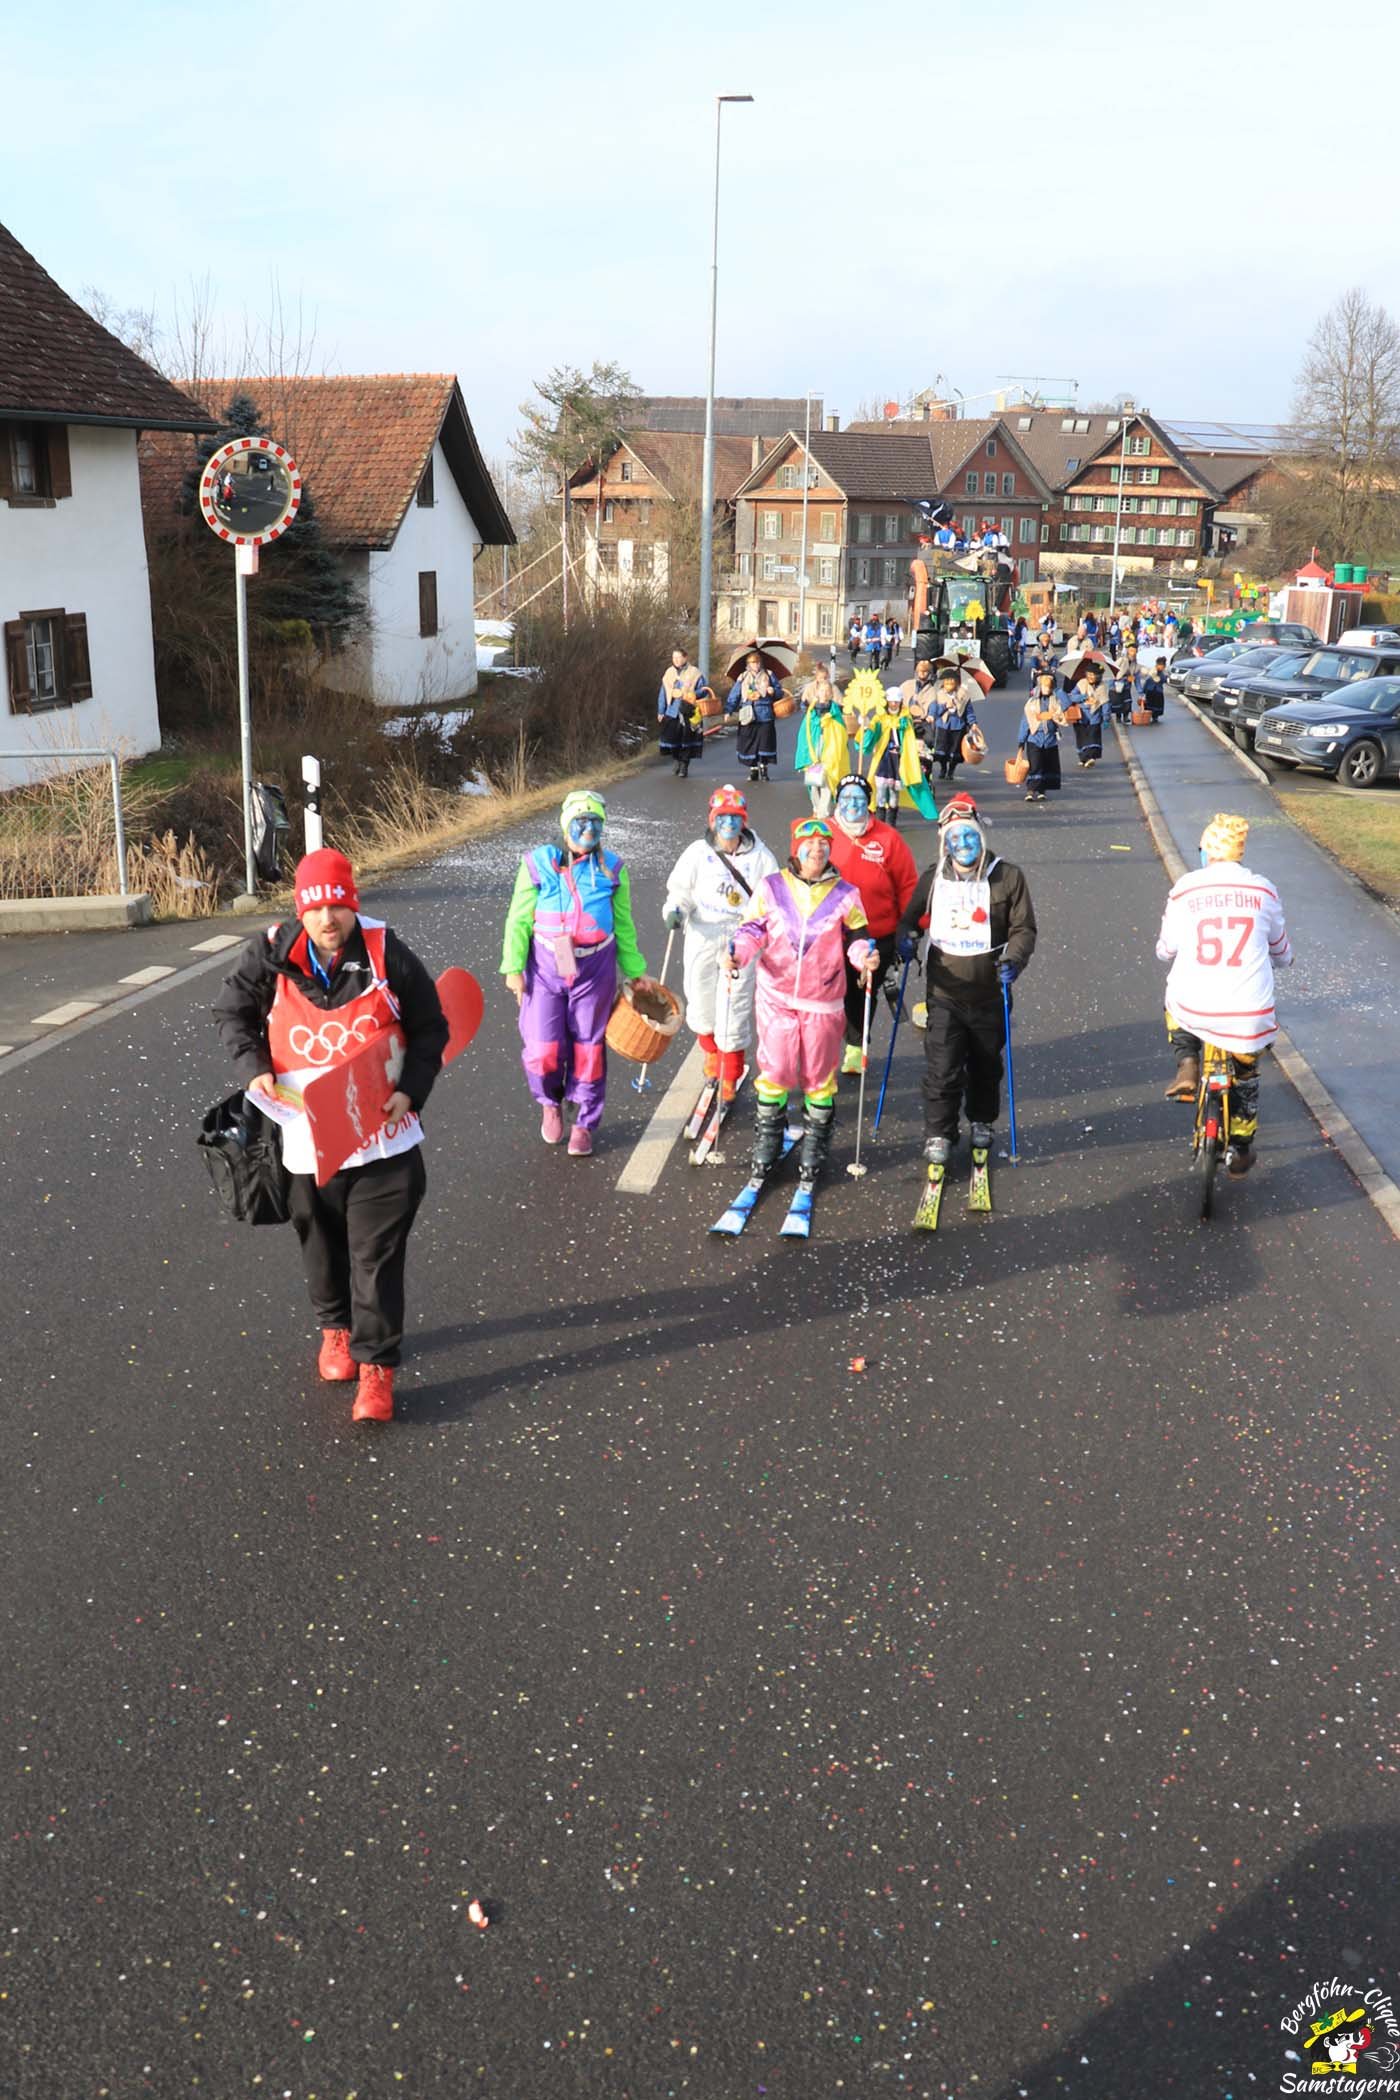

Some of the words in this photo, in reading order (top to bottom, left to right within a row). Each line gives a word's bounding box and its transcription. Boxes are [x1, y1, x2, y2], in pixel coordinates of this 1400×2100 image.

[859, 686, 874, 699] 19
[1187, 890, 1262, 912] BERGFÖHN
[1196, 916, 1254, 967] 67
